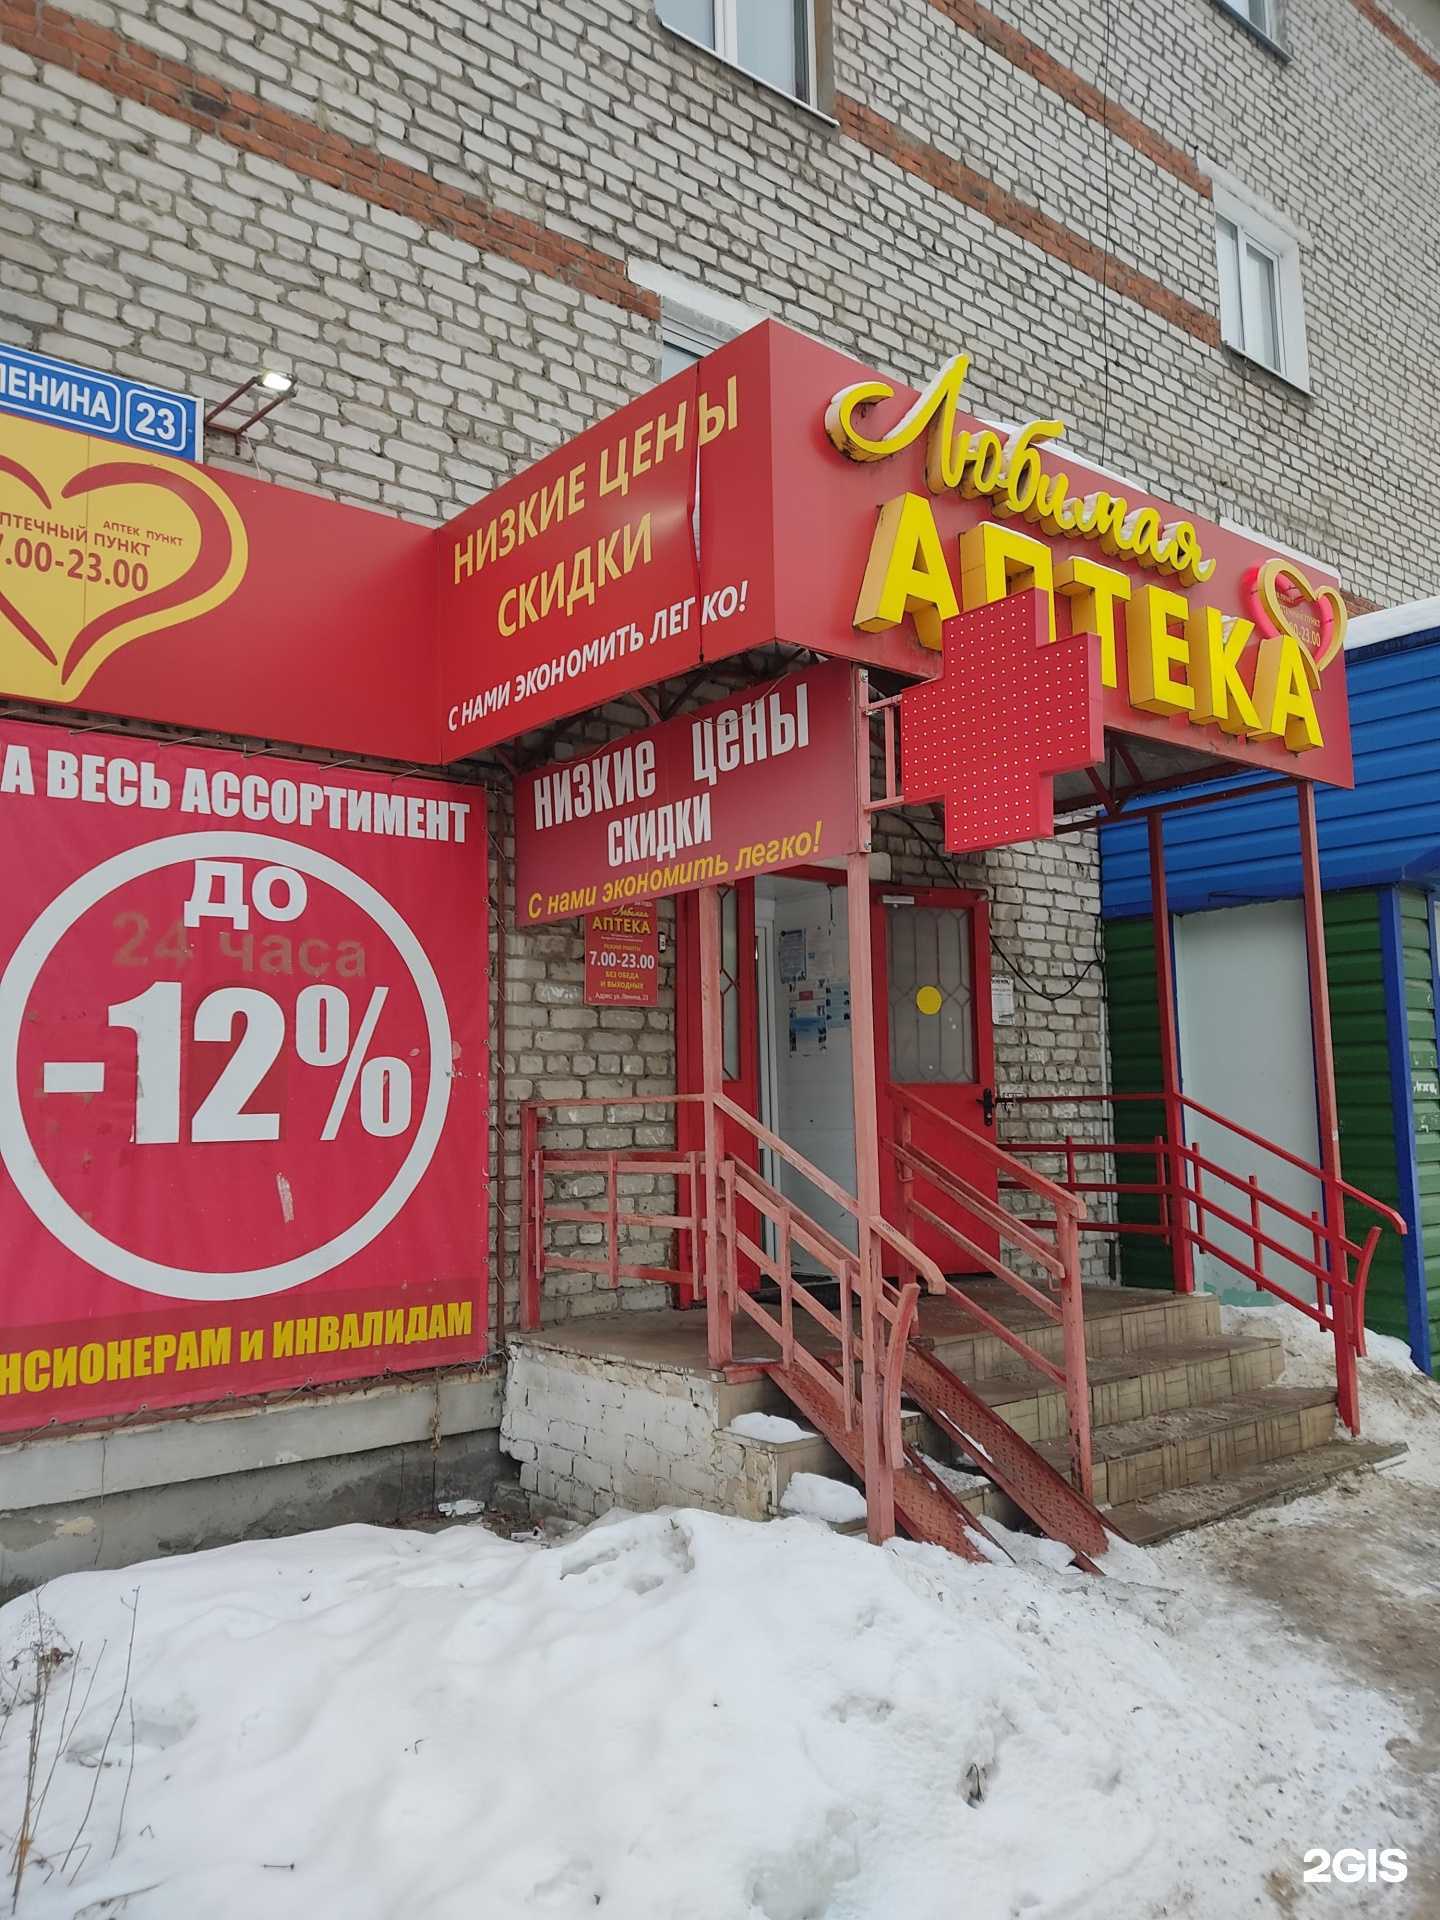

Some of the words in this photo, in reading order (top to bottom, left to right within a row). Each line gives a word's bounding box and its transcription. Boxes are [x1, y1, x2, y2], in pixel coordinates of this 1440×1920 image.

[135, 402, 176, 440] 23
[825, 353, 1217, 588] Любимая
[0, 533, 149, 592] .00-23.00
[94, 532, 151, 557] ПУНКТ
[103, 520, 140, 537] АПТЕК
[146, 530, 183, 547] ПУНКТ
[454, 462, 586, 584] НИЗКИЕ
[497, 512, 653, 637] СКИДКИ
[853, 492, 1324, 753] АПТЕКА
[448, 706, 458, 732] С
[460, 681, 510, 727] НАМИ
[514, 624, 643, 703] ЭКОНОМИТЬ
[46, 750, 171, 809] ВЕСЬ
[180, 767, 471, 844] АССОРТИМЕНТ
[548, 886, 596, 916] нами
[602, 858, 728, 904] экономить
[735, 820, 823, 872] легко!
[589, 950, 655, 970] 7.00-23.00
[592, 915, 651, 935] АПТЕКА
[43, 980, 413, 1145] -12%
[272, 1301, 473, 1358] ИНВАЛИДАМ
